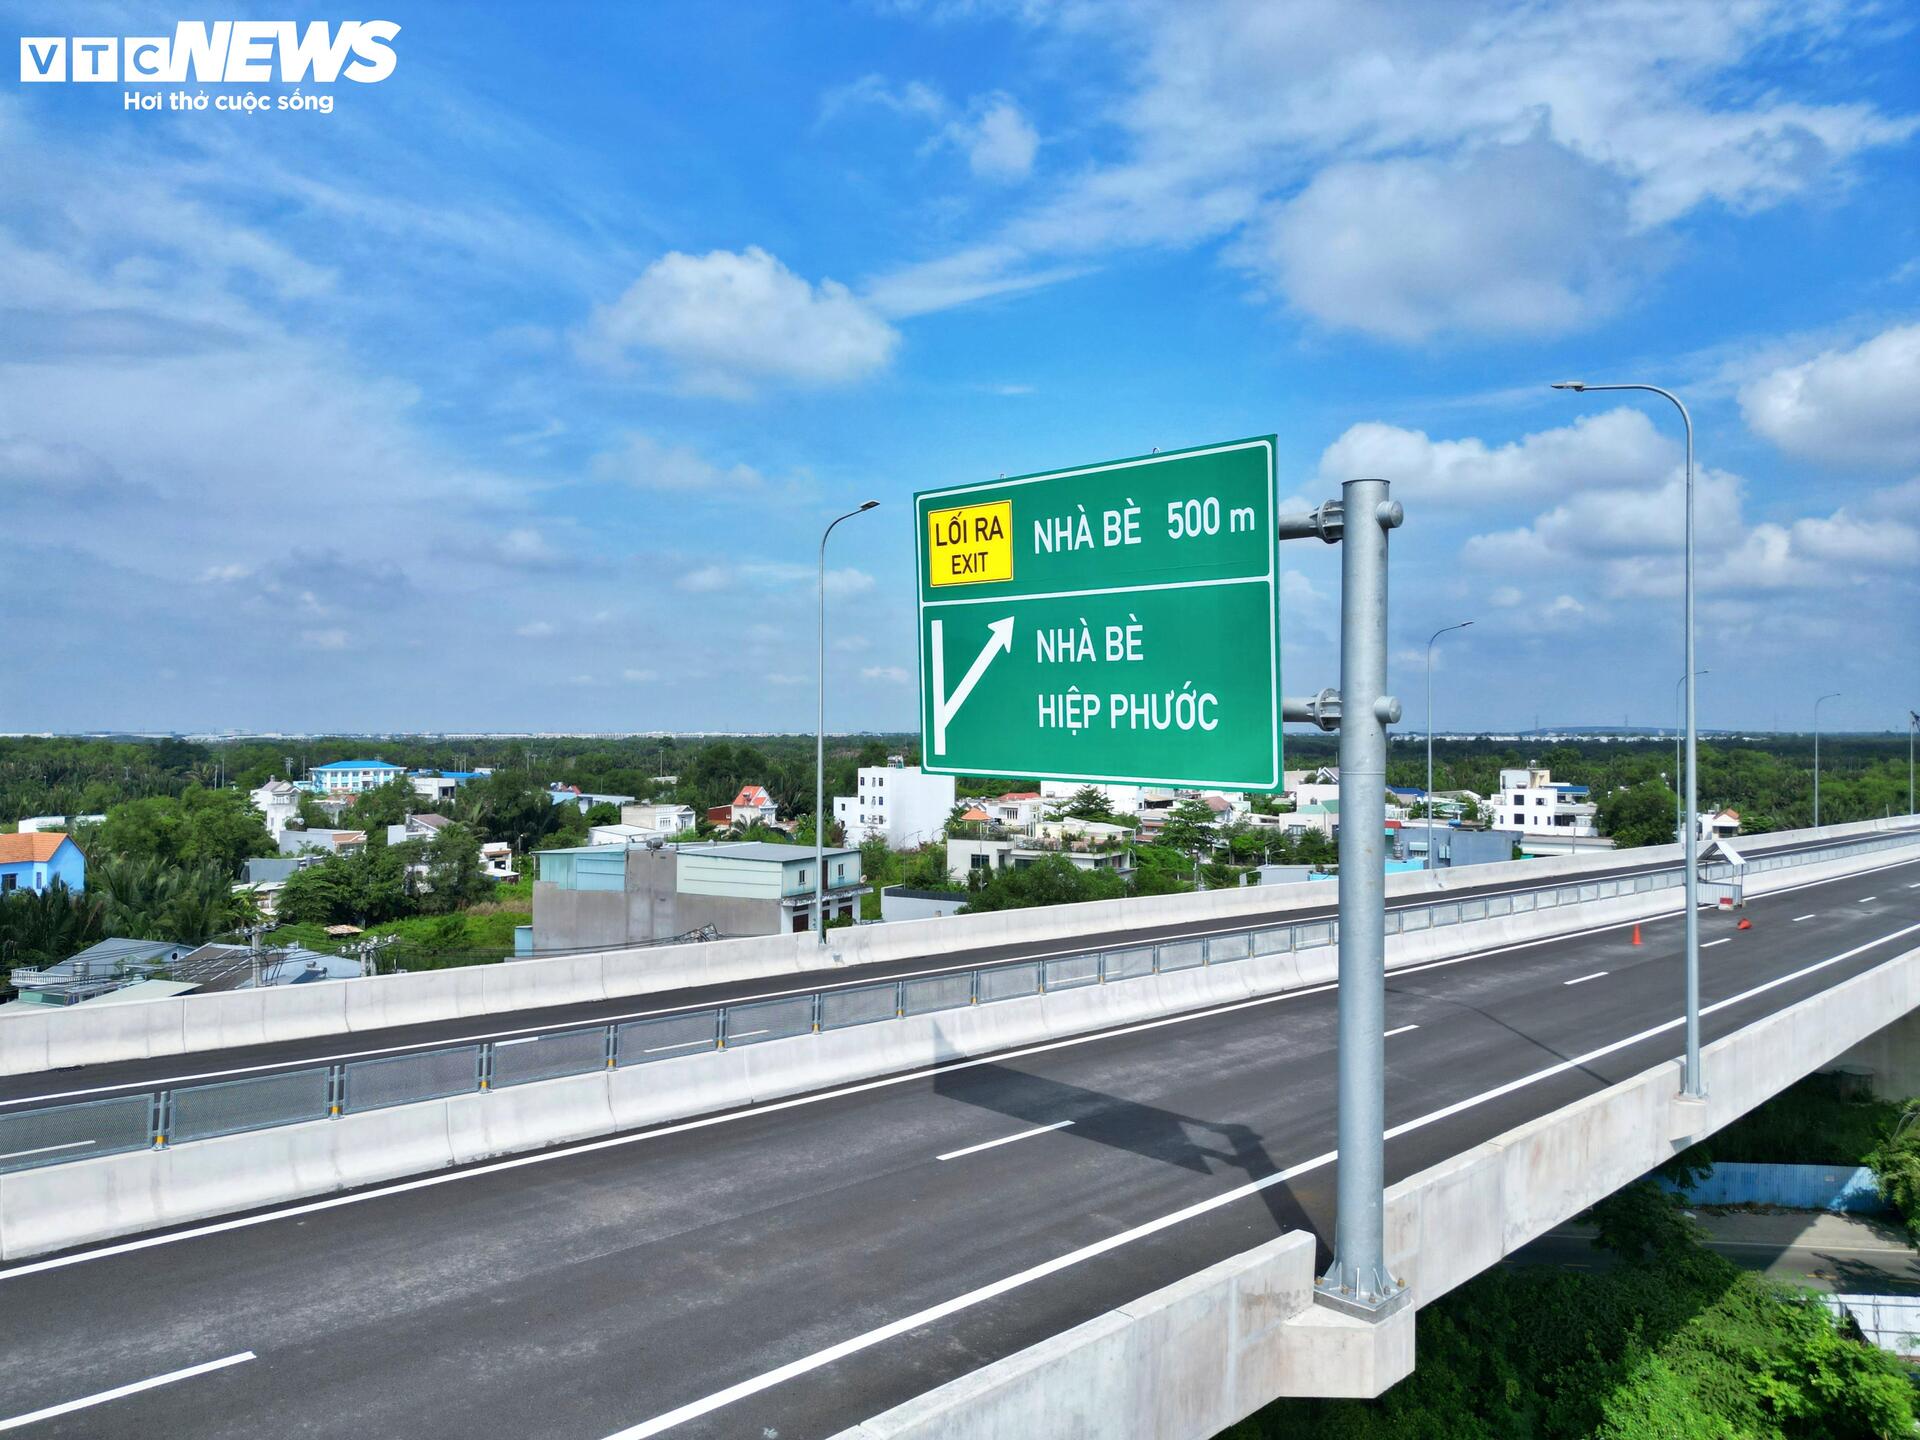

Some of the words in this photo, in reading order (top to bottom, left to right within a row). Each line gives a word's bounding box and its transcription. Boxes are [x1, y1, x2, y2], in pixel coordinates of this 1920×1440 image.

[935, 511, 968, 547] LỐI
[975, 515, 1004, 543] RA
[1033, 504, 1095, 555] NHÀ
[1103, 497, 1142, 547] BÈ
[1167, 496, 1221, 540] 500
[1230, 505, 1256, 533] m
[951, 551, 989, 575] EXIT
[1036, 617, 1097, 663] NHÀ
[1105, 613, 1144, 662] BÈ
[1038, 685, 1101, 736] HIỆP
[1110, 680, 1219, 731] PHƯỚC
